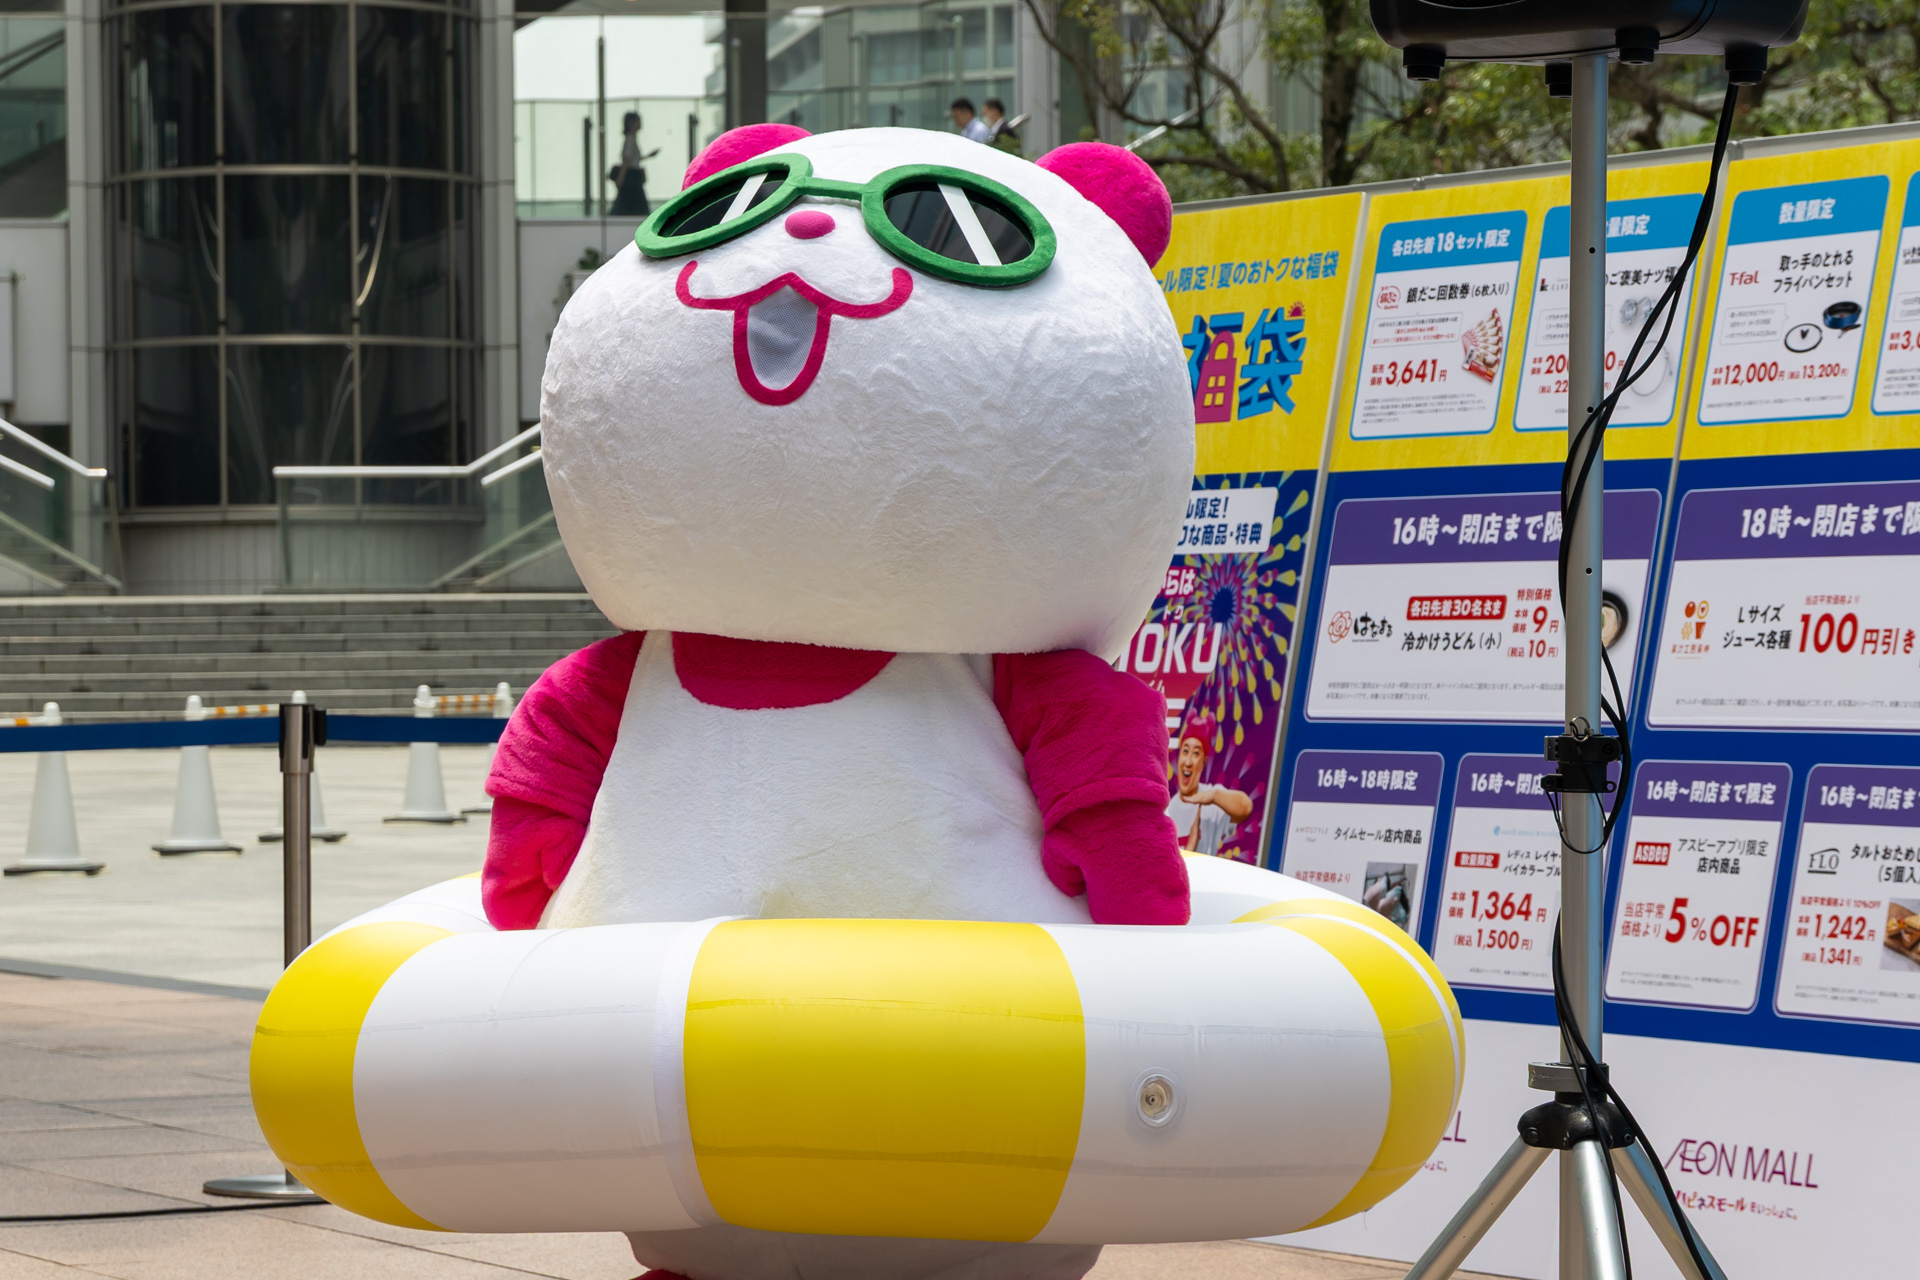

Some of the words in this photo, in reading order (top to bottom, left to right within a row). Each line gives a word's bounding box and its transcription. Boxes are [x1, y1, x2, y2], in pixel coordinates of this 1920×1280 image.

[1779, 197, 1836, 224] 数量限定
[1606, 213, 1650, 237] 量限定
[1392, 228, 1511, 257] 各日先着18セット限定
[1779, 250, 1853, 271] 取っ手のとれる
[1774, 271, 1853, 293] フライパンセット
[1182, 303, 1307, 424] 福袋
[1163, 568, 1195, 596] らは
[1517, 588, 1553, 600] 特別価格
[1410, 599, 1502, 618] 各日先着30名さま
[1514, 609, 1528, 619] 本体
[1353, 612, 1393, 638] はなまる
[1512, 623, 1527, 633] 価格
[1401, 631, 1503, 652] 冷かけうどん（小）
[1723, 630, 1792, 650] ジュース各種
[1317, 768, 1418, 791] 16時～18時限定
[1471, 772, 1553, 795] 16時～閉店
[1647, 779, 1776, 805] 16時～閉店まで限定
[1820, 784, 1920, 810] 16時～閉店ま
[1334, 827, 1422, 844] タイムセール店内商品
[1535, 851, 1561, 862] レイヤ
[1634, 843, 1669, 863] ASBee
[1677, 838, 1769, 857] アスビーアプリ限定
[1460, 853, 1495, 867] 数量限定
[1697, 857, 1740, 874] 店内商品
[1808, 849, 1840, 870] FLO
[1451, 891, 1466, 902] 本体
[1449, 906, 1464, 918] 価格
[1624, 902, 1665, 919] 当店平常
[1621, 920, 1661, 938] 価格より
[1743, 1145, 1818, 1189] MALL
